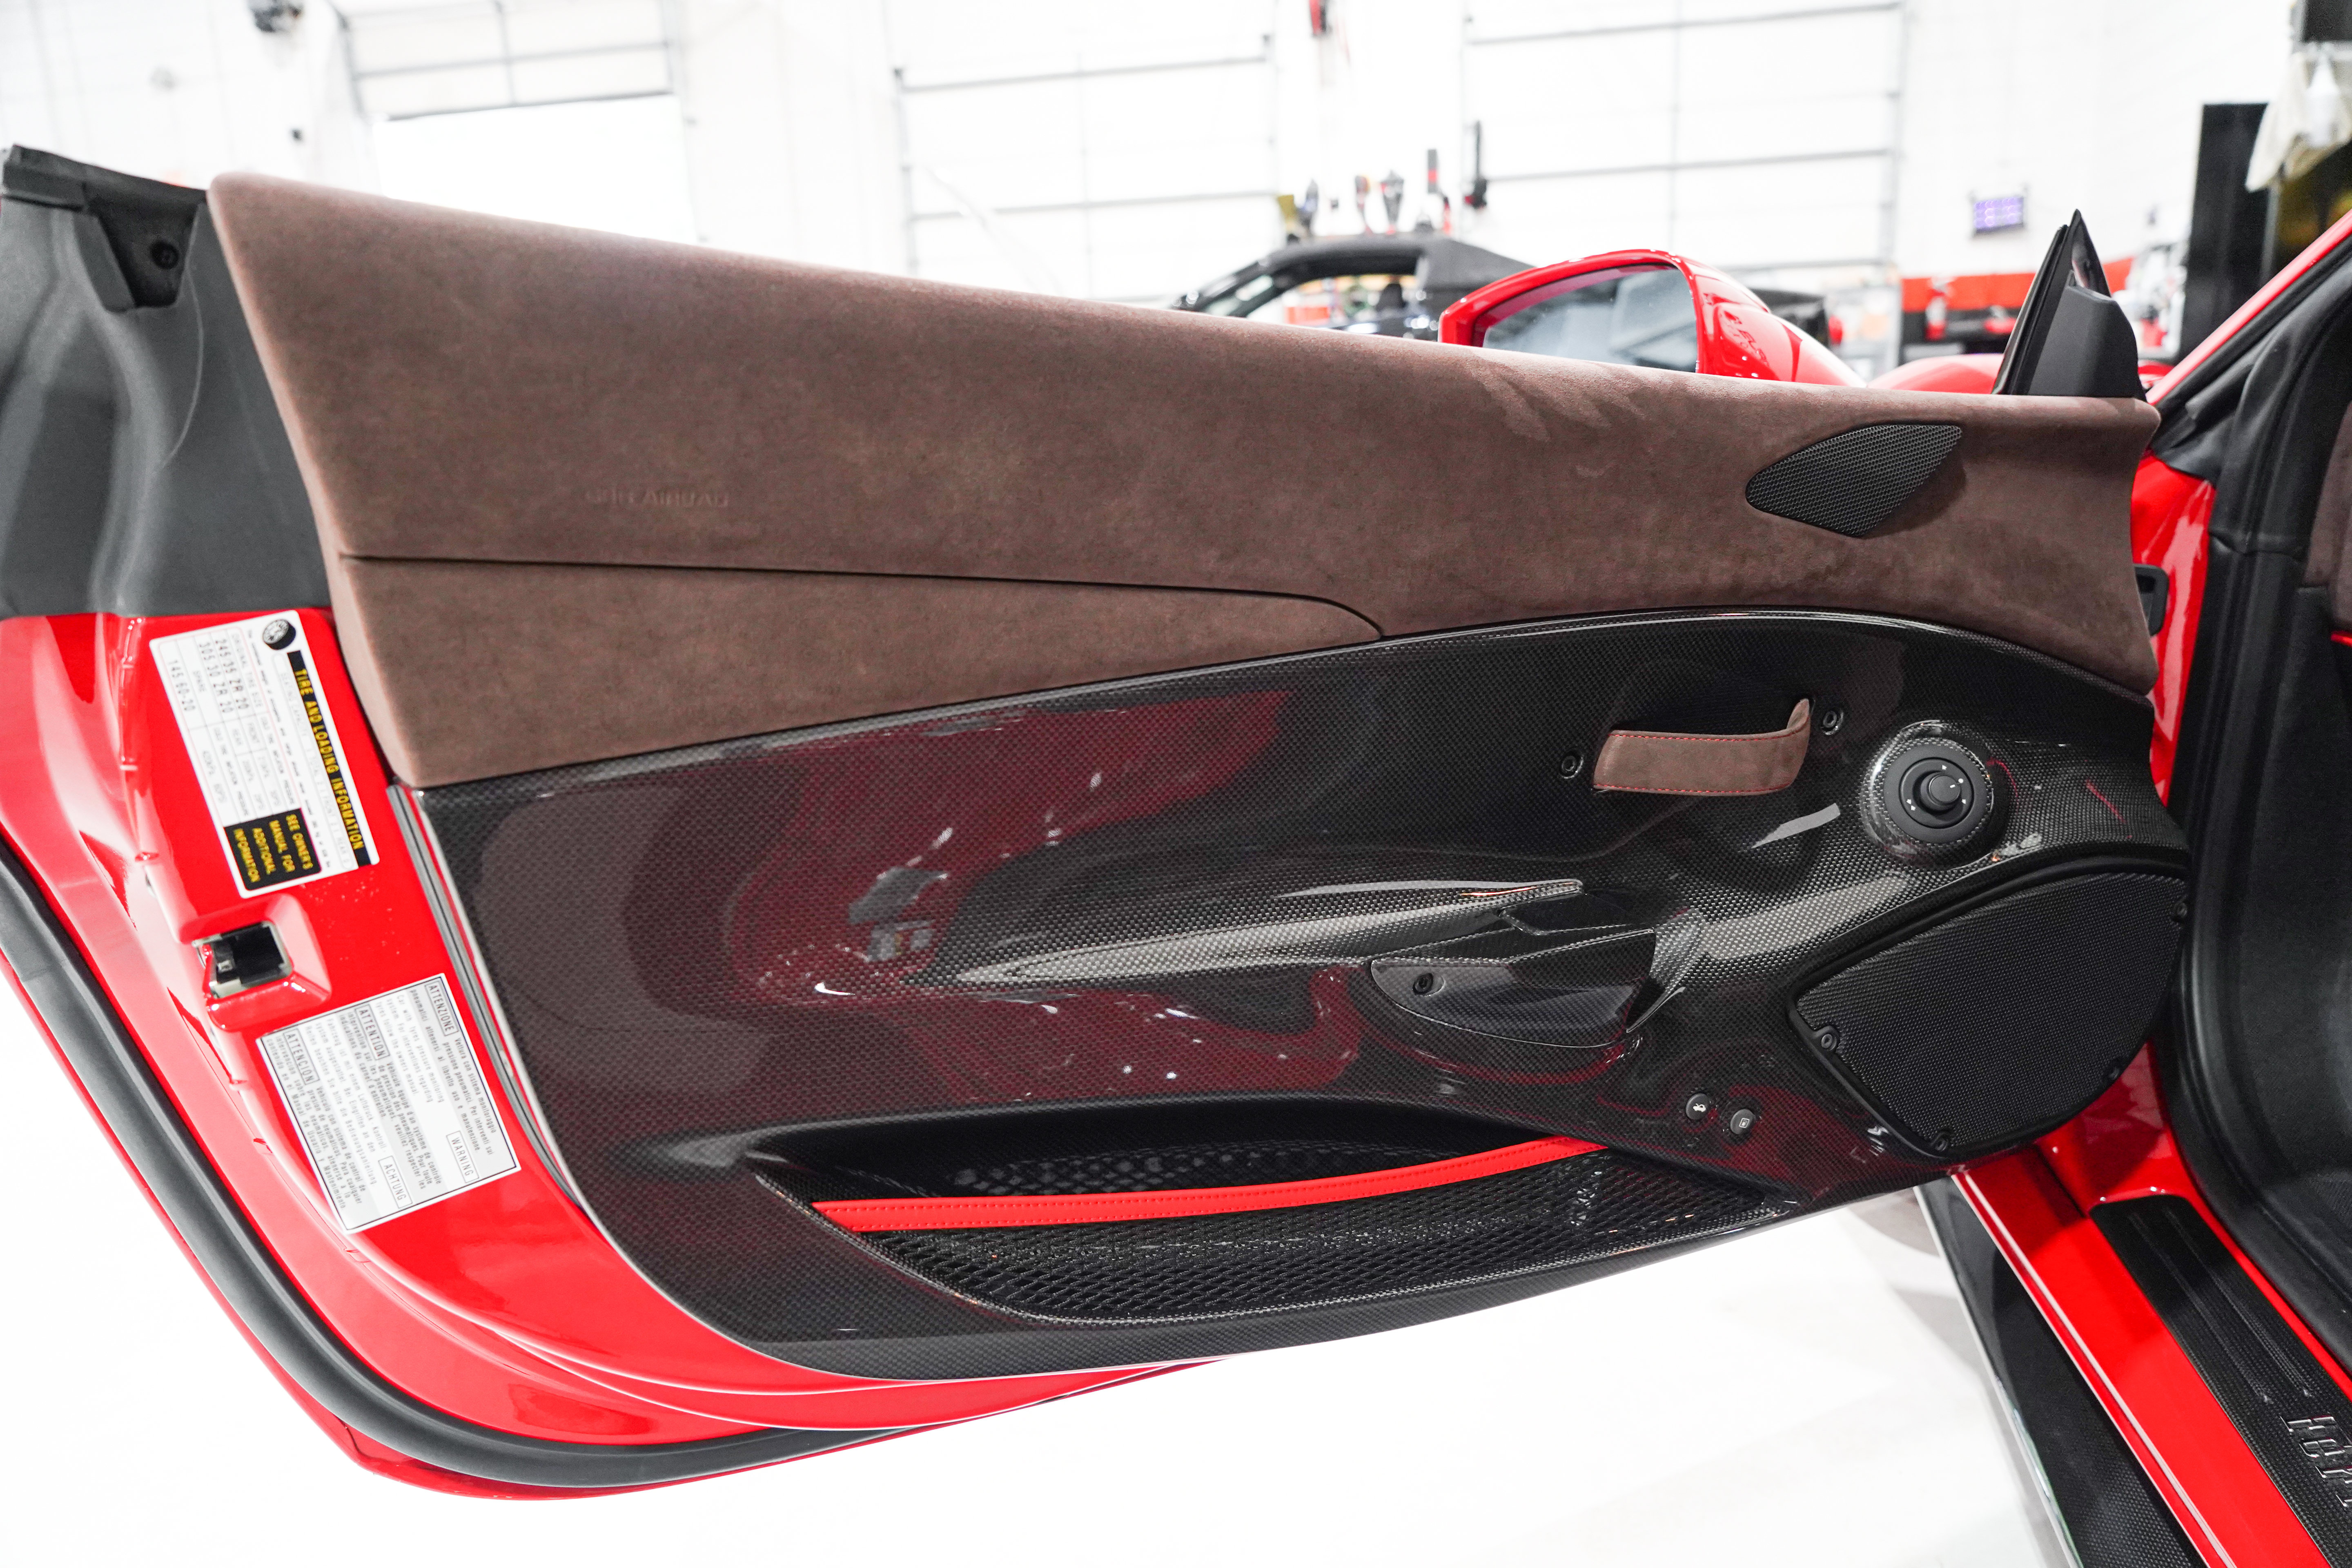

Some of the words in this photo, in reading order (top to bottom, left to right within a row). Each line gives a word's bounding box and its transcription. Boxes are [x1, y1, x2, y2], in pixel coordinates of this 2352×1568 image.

[192, 670, 207, 693] SPARE
[212, 681, 228, 697] ZR
[228, 678, 245, 693] ZR
[243, 671, 257, 688] TIRE
[250, 691, 263, 708] SIZE
[293, 668, 314, 696] TIRE
[219, 700, 234, 714] 20
[235, 697, 251, 710] 20
[304, 699, 323, 724] AND
[312, 724, 340, 773] LOADING
[284, 813, 301, 832] SEE
[330, 777, 365, 850] INFORMATION
[231, 827, 262, 884] INFORMATION
[249, 826, 278, 875] ADDITIONAL
[267, 819, 290, 855] MANUAL
[279, 853, 296, 874] FOR
[374, 1001, 387, 1018] tyres
[428, 984, 455, 1032] ATTENZIONE
[358, 1008, 387, 1057] ATTENTION
[381, 1018, 396, 1038] follow
[396, 1022, 407, 1033] For
[324, 1018, 344, 1047] Fahrzeug
[338, 1048, 347, 1057] ist
[343, 1059, 353, 1070] mit
[348, 1072, 361, 1091] einem
[390, 1038, 401, 1049] the
[396, 993, 407, 1006] Car
[402, 1009, 413, 1022] with
[408, 1026, 421, 1042] tyres
[416, 1044, 432, 1070] pressure
[426, 1071, 446, 1103] monitoring
[400, 1034, 423, 1074] interventions
[409, 988, 430, 1022] pneumatici
[425, 1025, 441, 1052] attenersi
[441, 1065, 456, 1087] libretto
[451, 1090, 460, 1101] uso
[285, 1032, 316, 1082] ATTENCION
[353, 1051, 363, 1060] du
[358, 1062, 373, 1082] carnet
[395, 1050, 410, 1072] owners
[442, 1041, 460, 1070] pressione
[281, 1073, 289, 1081] en
[377, 1065, 386, 1073] de
[314, 1048, 332, 1075] beachten
[326, 1077, 338, 1088] Sie
[332, 1090, 344, 1105] bitte
[339, 1107, 350, 1117] die
[343, 1087, 354, 1098] Bei
[381, 1074, 397, 1099] pression
[416, 1074, 434, 1103] regarding
[453, 1037, 468, 1059] Vettura
[463, 1060, 472, 1071] con
[468, 1072, 482, 1096] sistema
[476, 1096, 498, 1134] monitoraggio
[290, 1094, 307, 1117] Manual
[346, 1011, 369, 1049] intervention
[363, 1051, 373, 1062] sur
[369, 1064, 380, 1075] les
[393, 1123, 410, 1147] veuillez
[403, 1149, 422, 1178] respecter
[417, 1179, 428, 1189] les
[392, 1100, 402, 1111] des
[469, 1105, 479, 1116] Per
[302, 1119, 311, 1128] de
[318, 1113, 327, 1122] de
[327, 1114, 337, 1125] con
[347, 1099, 368, 1129] Eingriffen
[293, 1079, 307, 1097] sobre
[303, 1100, 313, 1111] los
[326, 1154, 345, 1181] atenerse
[332, 1127, 349, 1150] sistema
[473, 1117, 490, 1145] interventi
[306, 1130, 323, 1154] Usuario
[366, 1140, 378, 1152] den
[485, 1145, 494, 1155] sui
[343, 1152, 353, 1160] de
[415, 1154, 428, 1168] Pour
[423, 1151, 432, 1159] de
[450, 1136, 474, 1176] WARNING
[339, 1161, 352, 1176] Para
[347, 1161, 363, 1182] control
[422, 1169, 434, 1185] toute
[345, 1177, 363, 1205] cualquier
[358, 1183, 367, 1192] de
[383, 1163, 407, 1200] ACHTUNG
